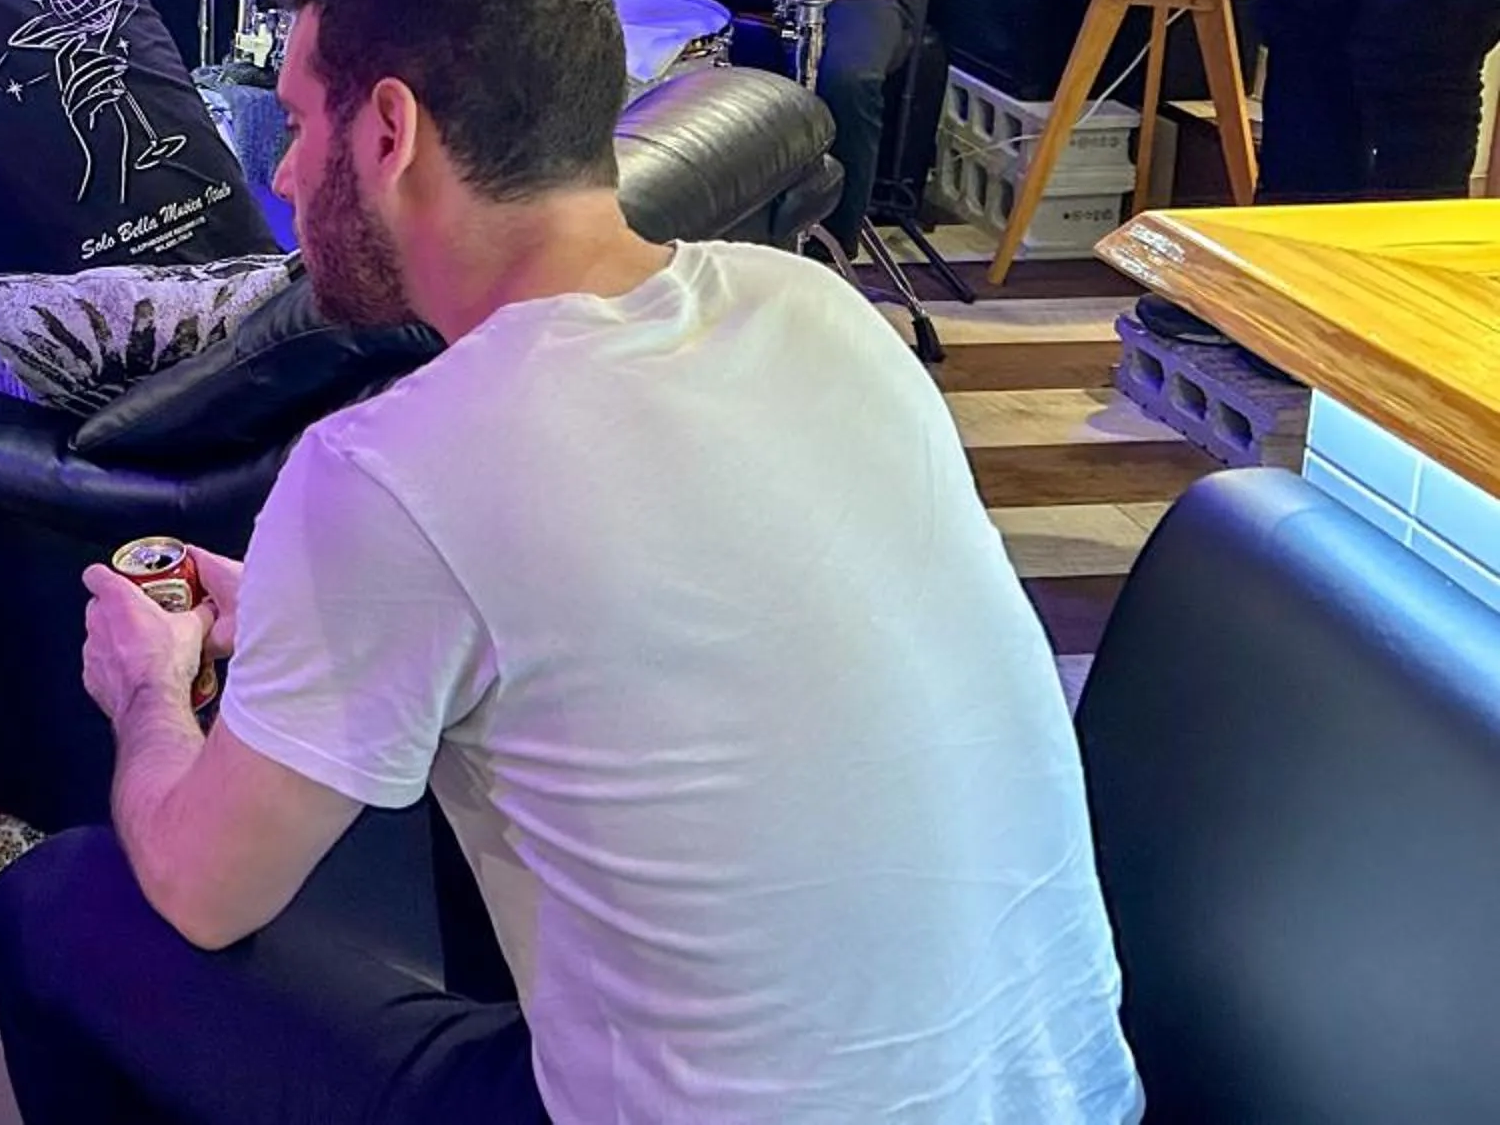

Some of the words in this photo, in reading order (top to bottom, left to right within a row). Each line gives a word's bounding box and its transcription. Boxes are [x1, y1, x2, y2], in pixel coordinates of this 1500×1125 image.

[80, 231, 116, 260] Solo
[117, 215, 159, 243] Bella
[159, 196, 203, 224] Musica
